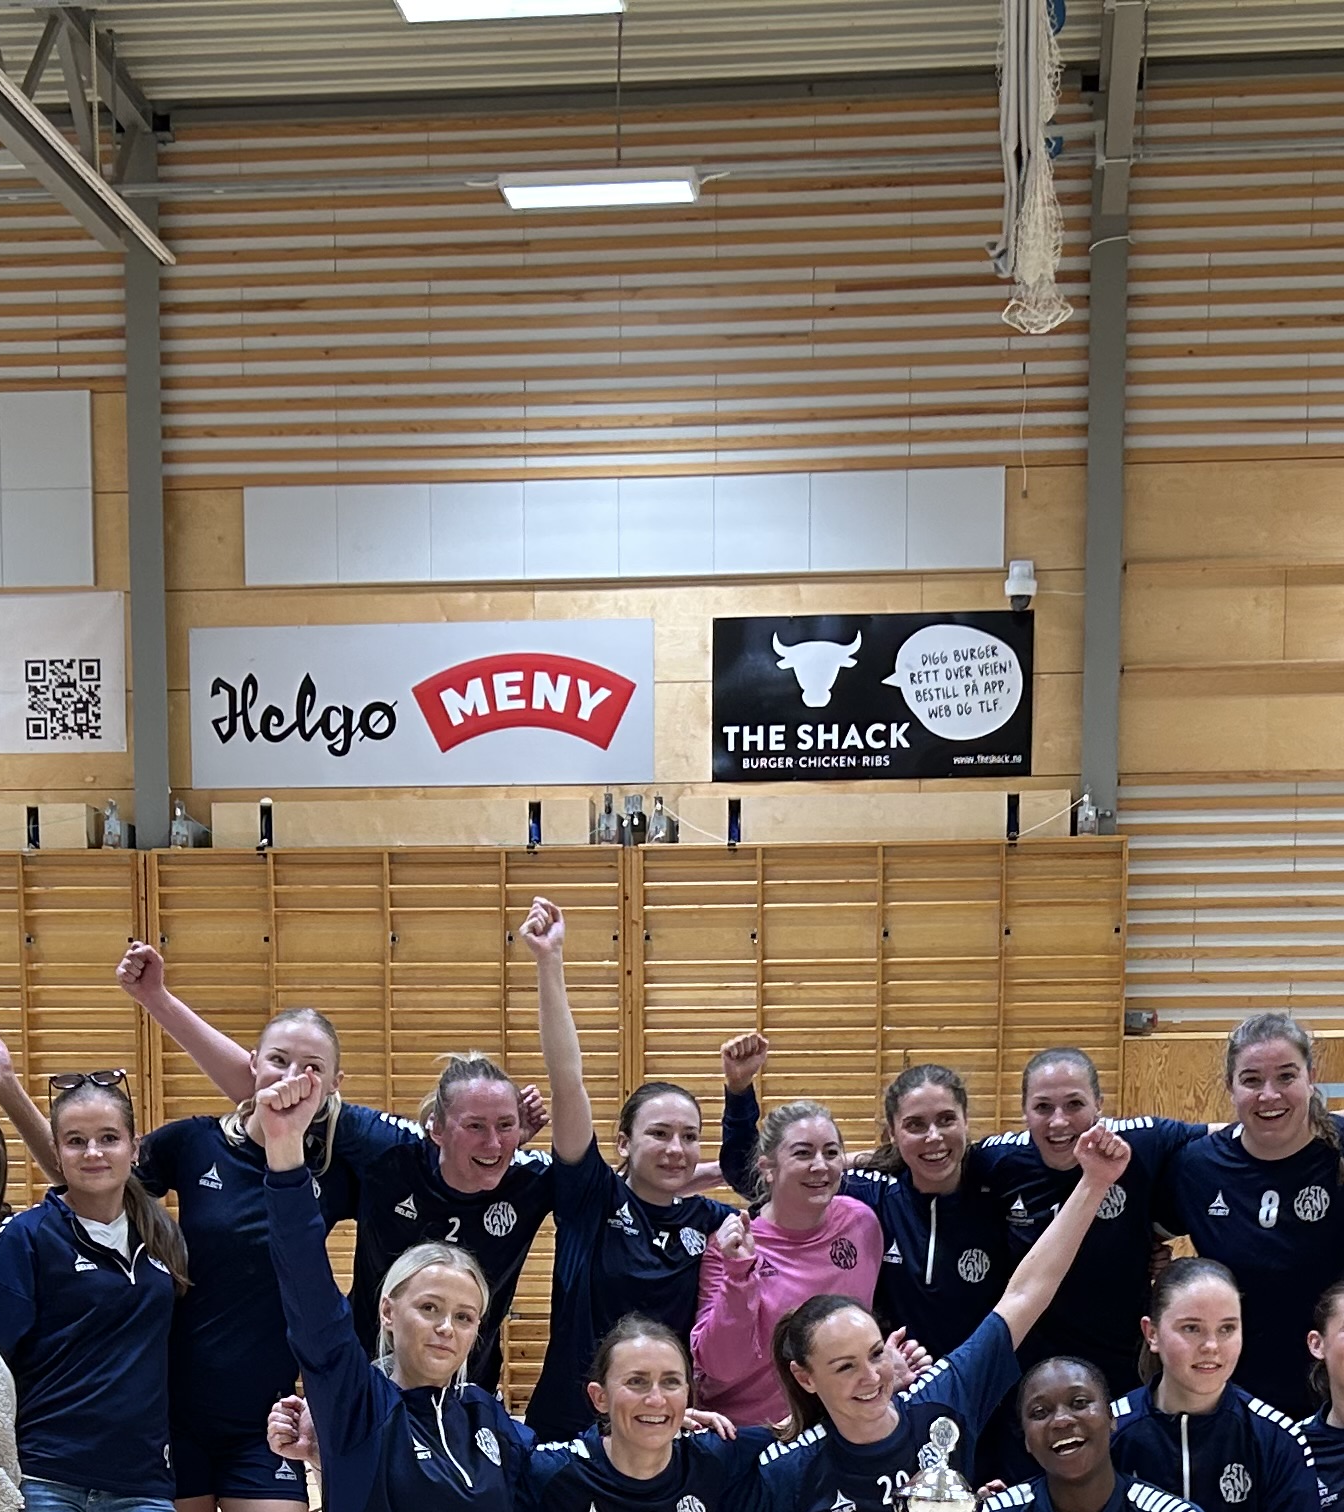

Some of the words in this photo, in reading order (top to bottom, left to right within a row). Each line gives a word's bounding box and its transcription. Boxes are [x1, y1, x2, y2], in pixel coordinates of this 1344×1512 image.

[921, 654, 948, 666] DIGG
[953, 645, 998, 662] BURGER
[910, 670, 939, 685] RETT
[945, 666, 973, 681] OVER
[979, 662, 1013, 677] VEIEN!
[439, 671, 612, 726] MENY
[915, 686, 959, 703] BESTILL
[964, 680, 980, 696] PÅ
[210, 672, 398, 757] Helgø
[928, 708, 952, 719] WEB
[956, 704, 973, 716] OG
[722, 725, 787, 752] THE
[796, 722, 911, 751] SHACK
[862, 755, 890, 767] RIBS
[1258, 1190, 1279, 1228] 8
[445, 1217, 460, 1243] 2
